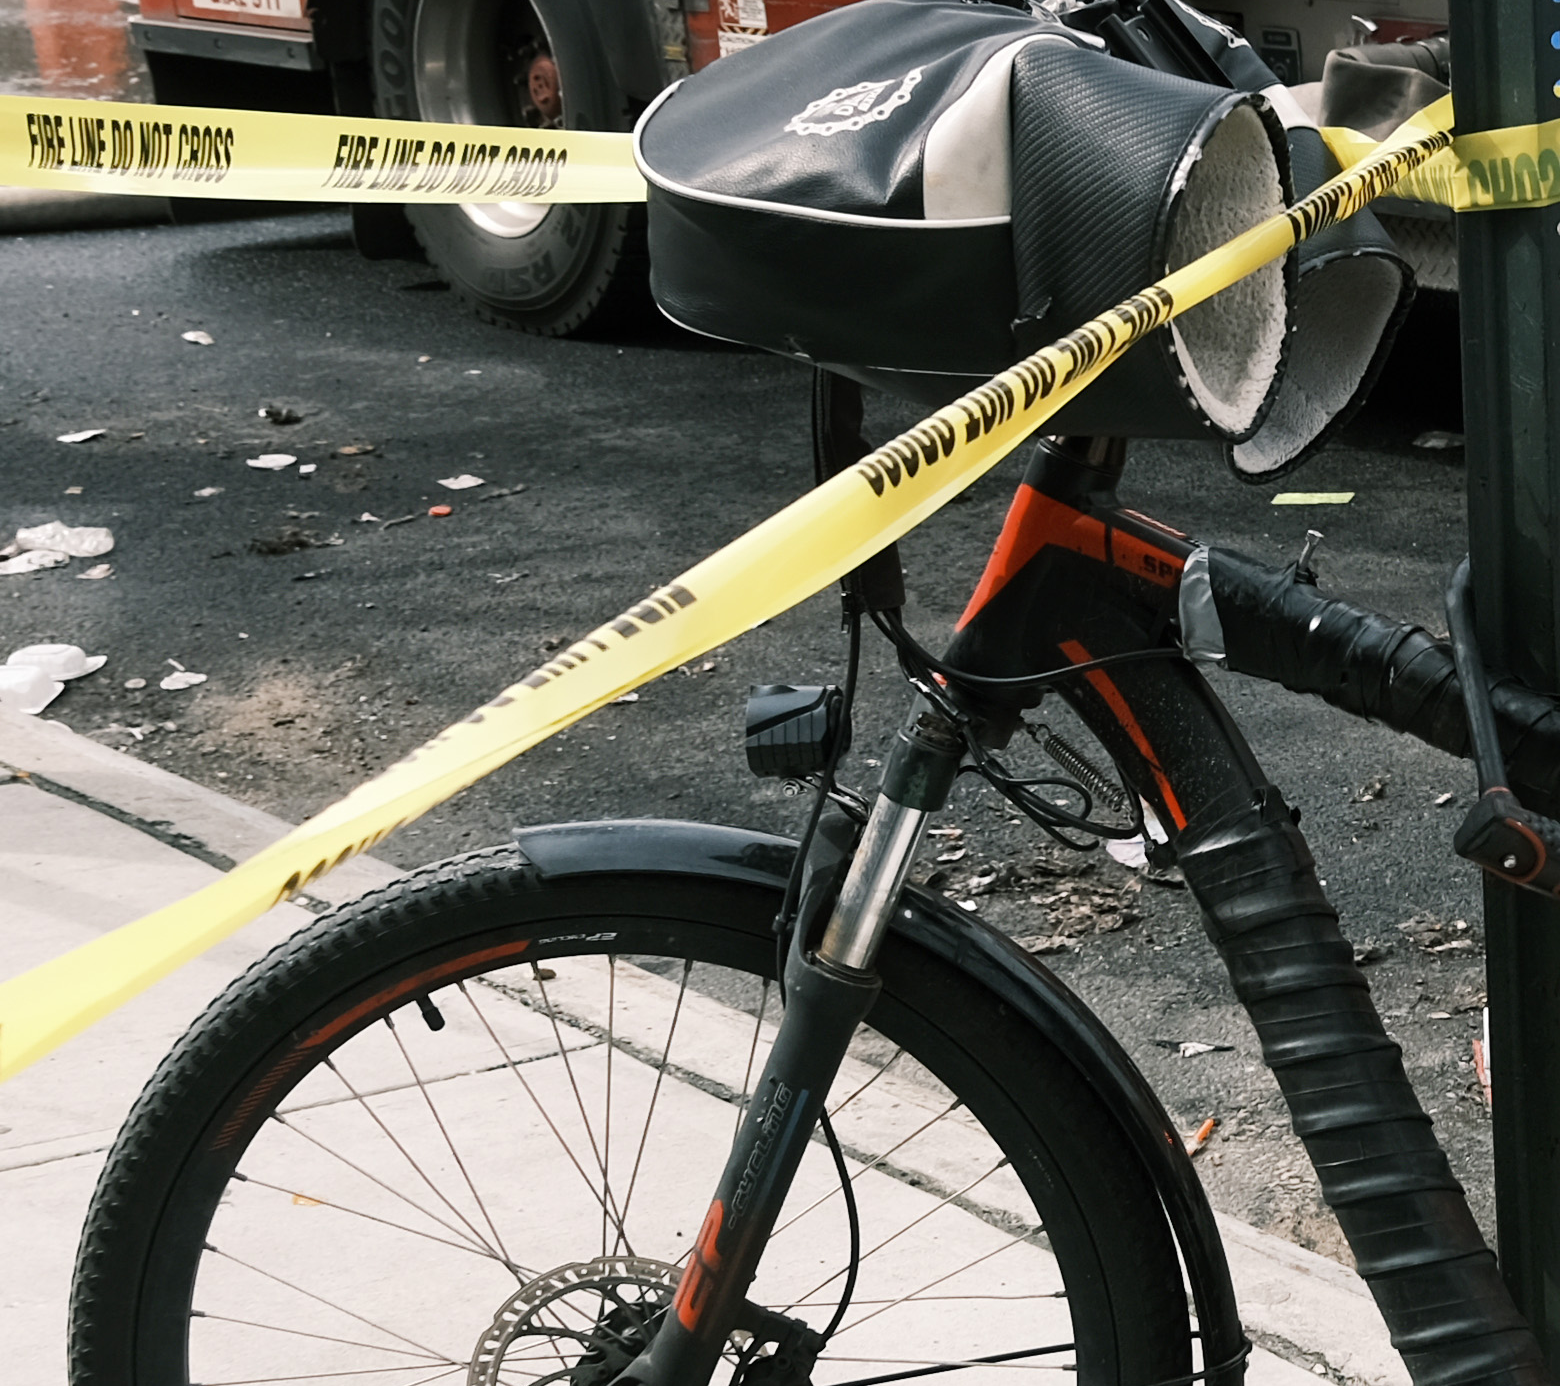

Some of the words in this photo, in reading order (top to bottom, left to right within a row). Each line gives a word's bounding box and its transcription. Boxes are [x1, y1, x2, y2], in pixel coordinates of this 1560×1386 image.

[26, 113, 67, 170] FIRE
[70, 116, 106, 174] LINE
[107, 119, 134, 176] DO
[135, 121, 173, 179] NOT
[172, 124, 235, 183] CROSS
[322, 134, 379, 189] FIRE
[368, 137, 425, 191] LINE
[412, 141, 456, 193] DO
[442, 143, 501, 195] NOT
[485, 146, 568, 198] CROSS
